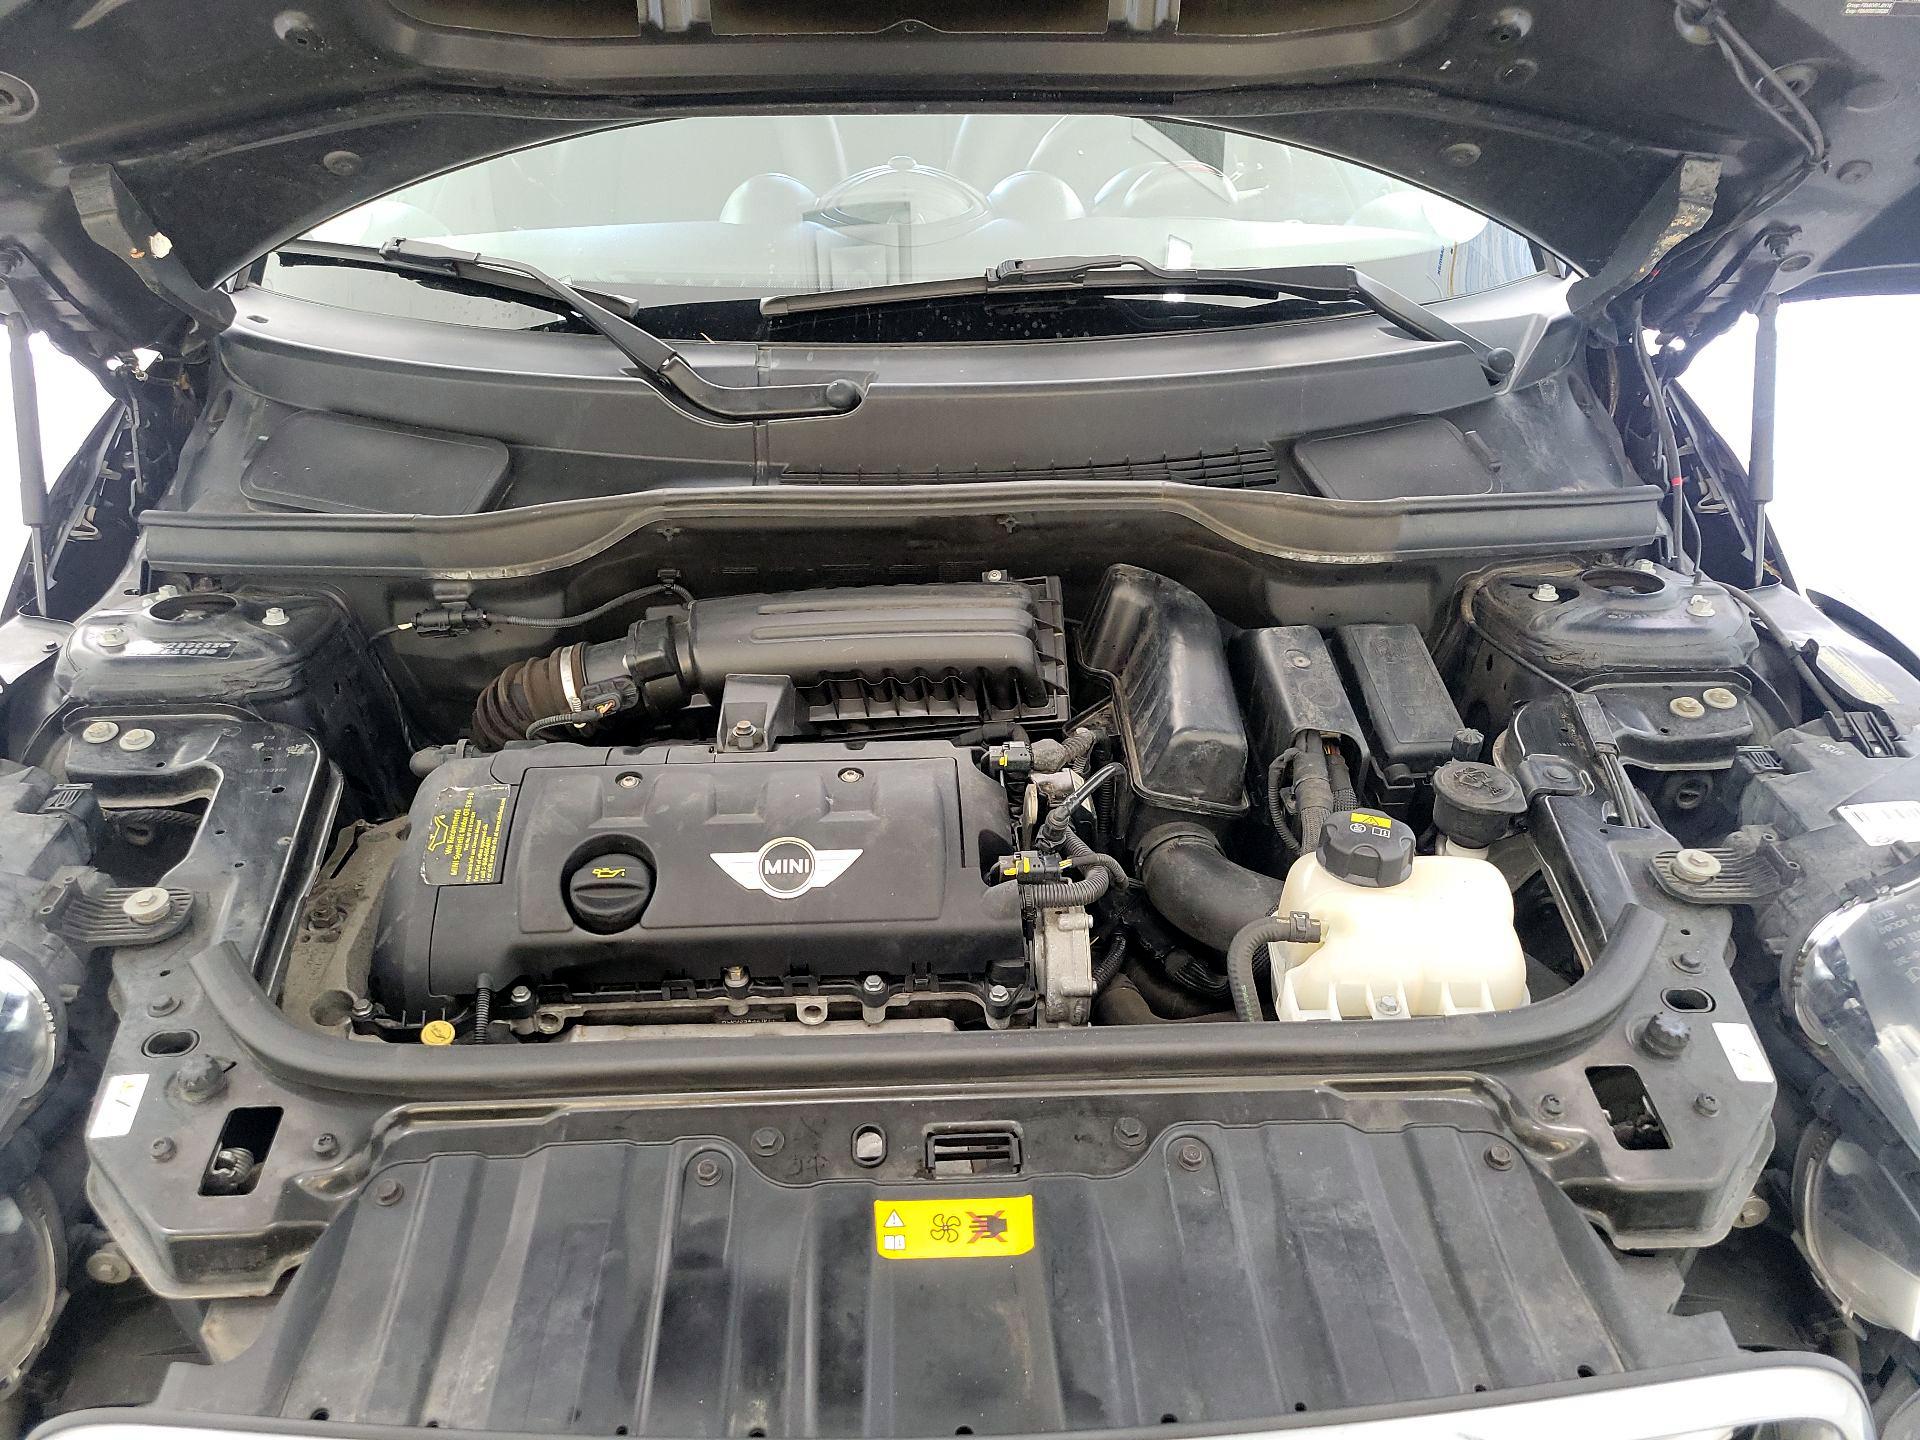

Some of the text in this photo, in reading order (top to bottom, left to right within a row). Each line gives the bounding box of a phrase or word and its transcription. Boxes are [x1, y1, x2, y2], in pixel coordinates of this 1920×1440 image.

[462, 807, 470, 816] Oil
[444, 809, 461, 854] We Recommend
[458, 815, 468, 833] Motor
[453, 833, 466, 860] Synthetic
[450, 859, 459, 875] MINI
[764, 858, 809, 875] MINI
